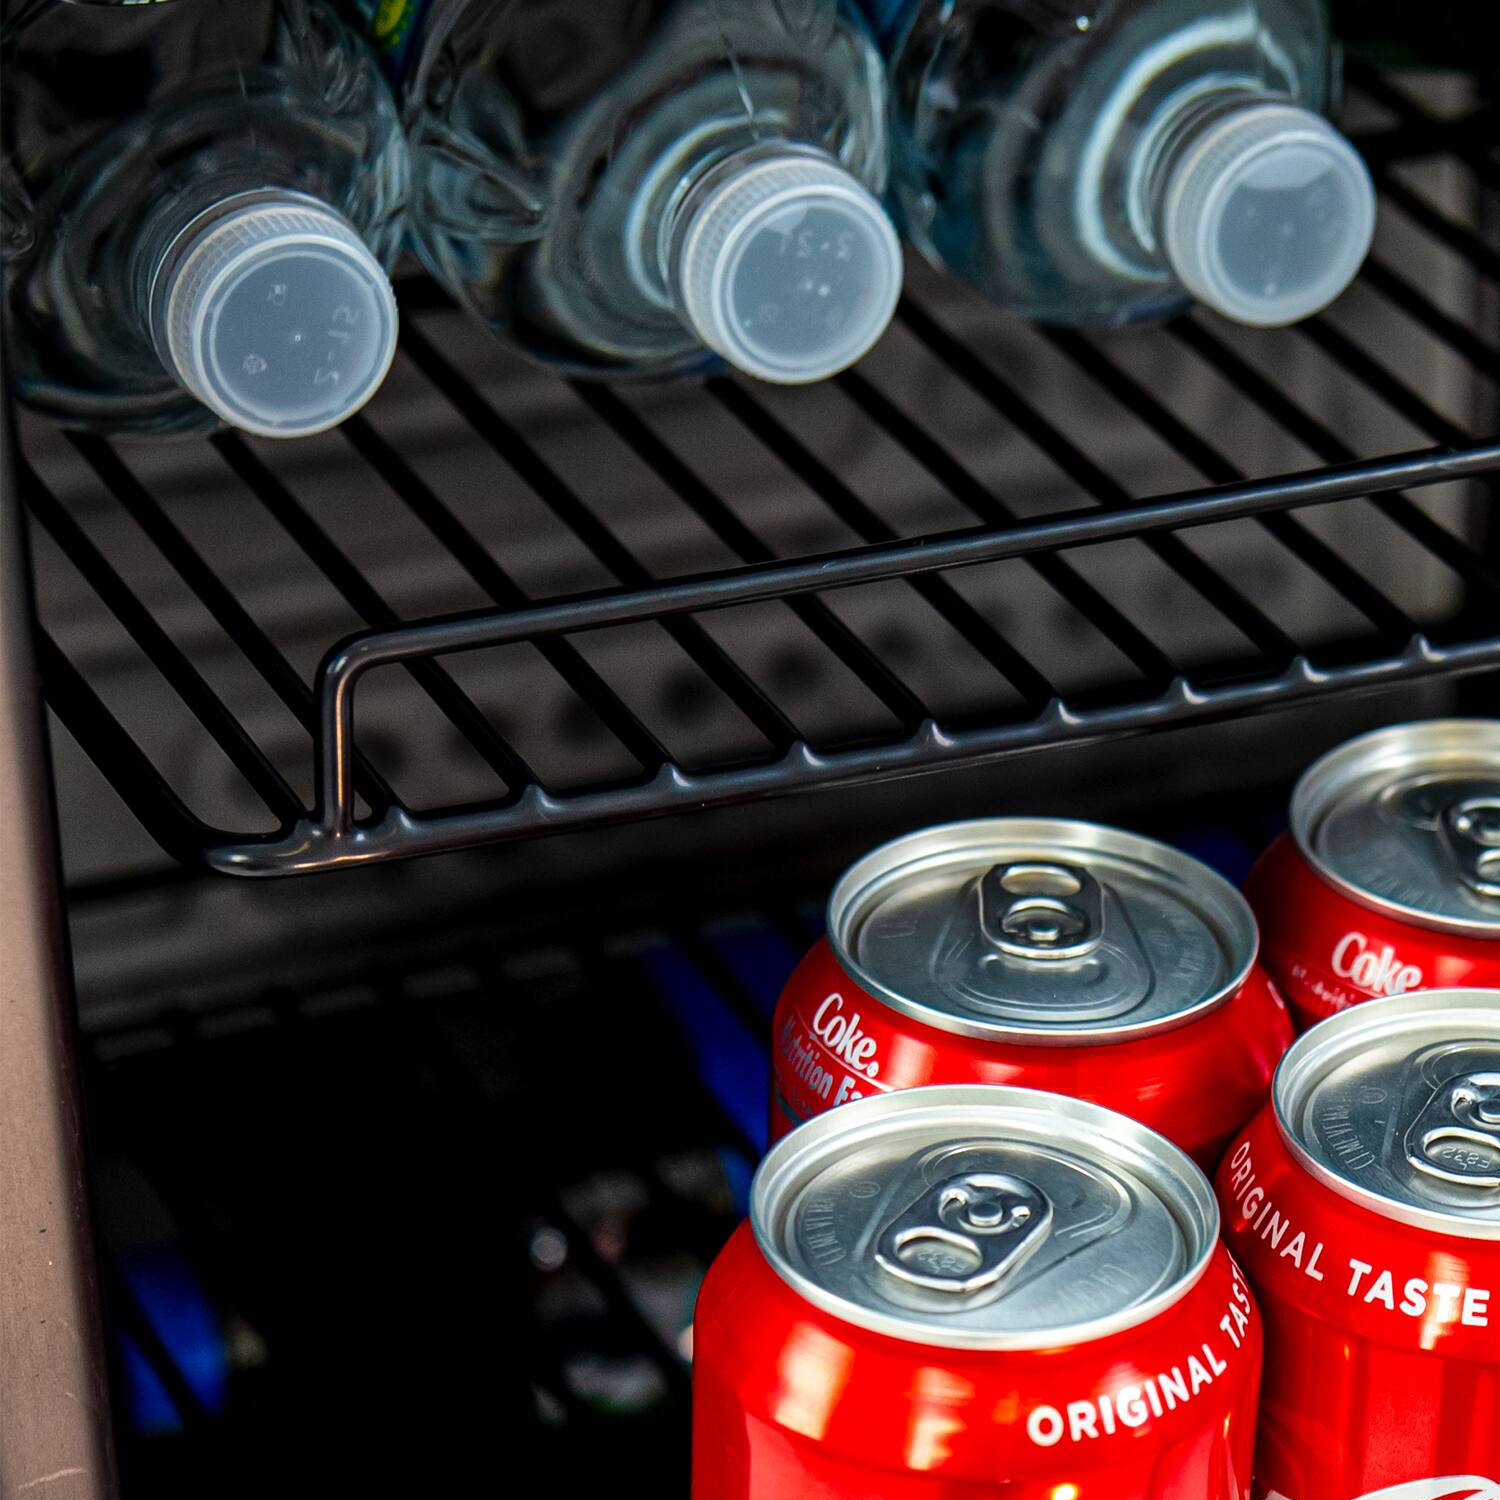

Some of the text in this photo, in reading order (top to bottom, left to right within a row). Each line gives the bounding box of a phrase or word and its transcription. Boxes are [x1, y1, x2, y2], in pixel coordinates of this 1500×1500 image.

[1331, 931, 1423, 996] Coke
[812, 992, 877, 1071] Coke
[1231, 1141, 1491, 1327] ORIGINAL TASTE
[1026, 1247, 1251, 1447] ORIGINAL TAST
